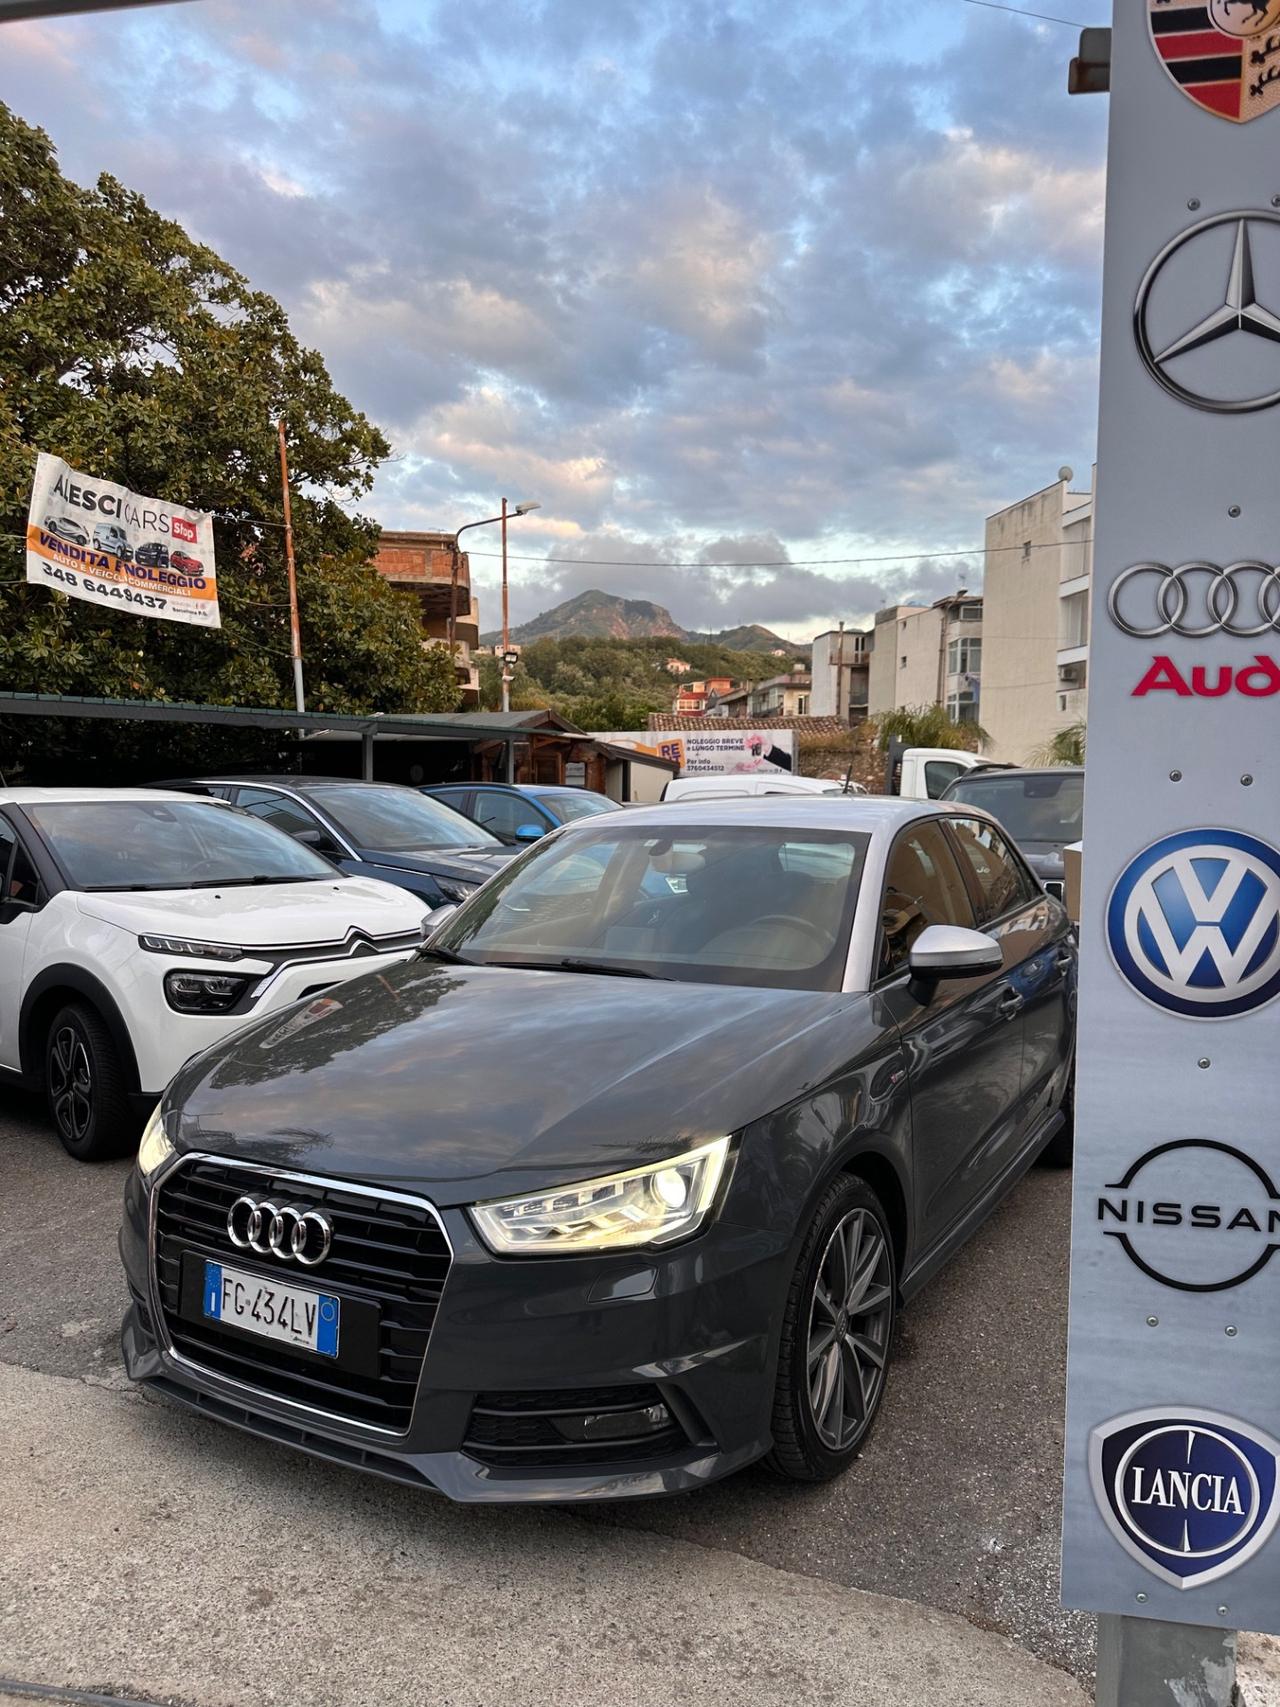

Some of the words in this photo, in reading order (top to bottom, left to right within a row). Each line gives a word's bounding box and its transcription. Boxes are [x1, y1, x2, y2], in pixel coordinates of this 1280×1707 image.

[172, 521, 194, 540] Stop
[39, 531, 110, 570] VENDITA
[124, 563, 207, 590] NOLEGGIO
[52, 553, 78, 570] AUTO
[80, 564, 87, 573] E
[128, 578, 192, 597] COMMERCIALI
[42, 561, 78, 587] 348
[82, 579, 168, 611] 6449437
[1131, 1466, 1246, 1516] LANCIA
